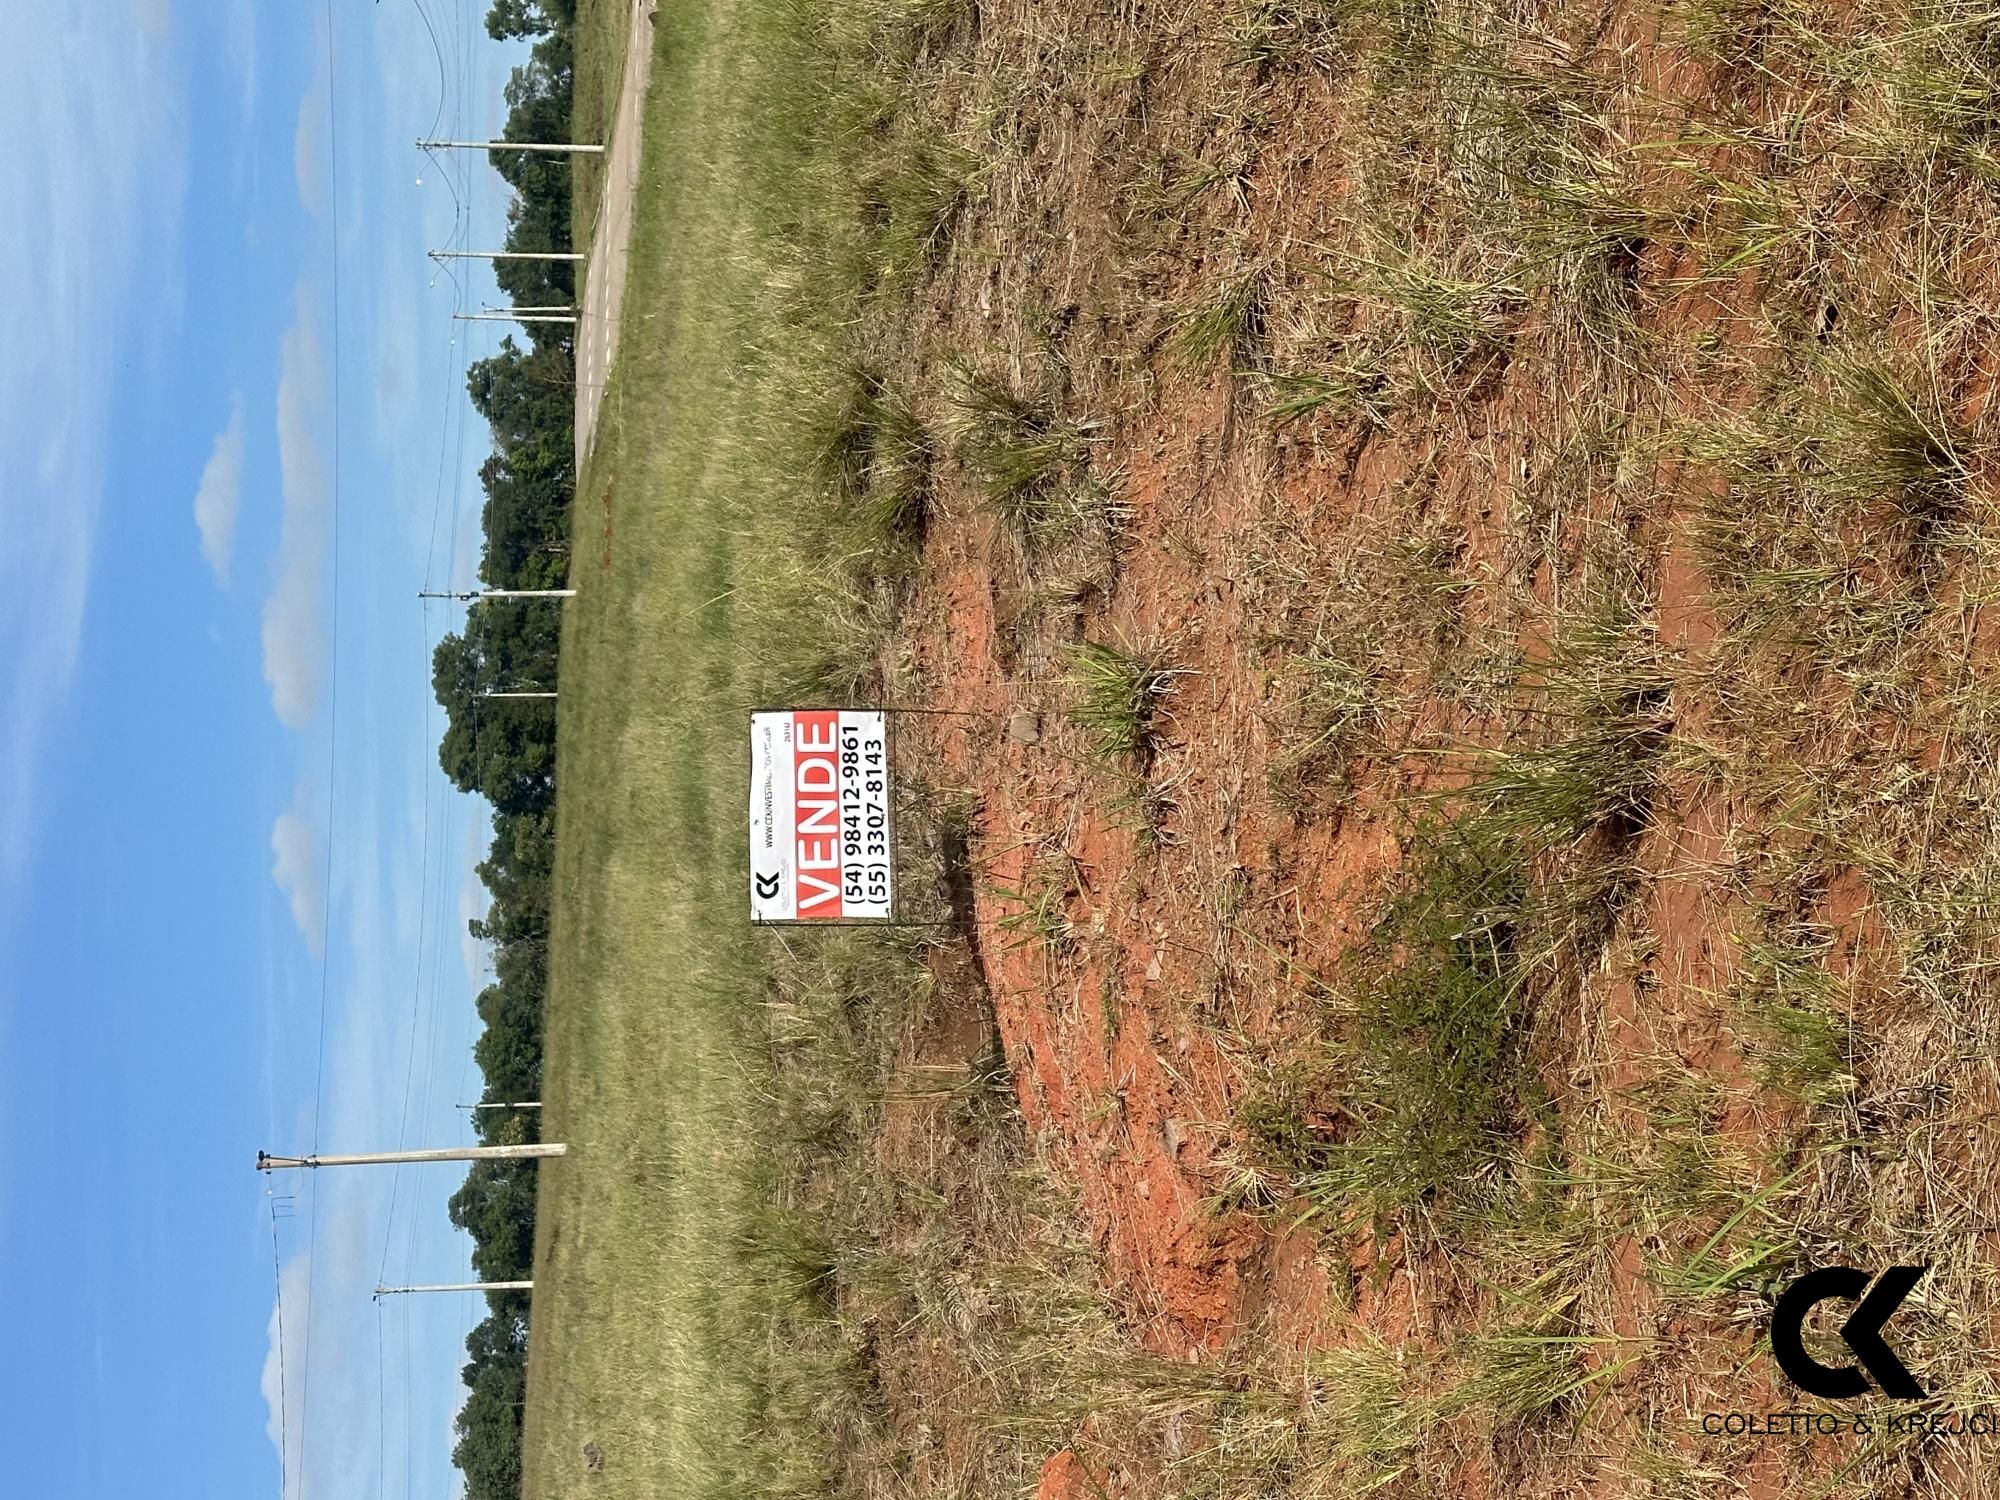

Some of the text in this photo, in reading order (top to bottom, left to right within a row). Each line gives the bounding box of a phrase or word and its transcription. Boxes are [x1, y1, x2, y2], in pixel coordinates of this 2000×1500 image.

[756, 872, 780, 899] CK
[796, 722, 840, 909] VENDE
[842, 726, 865, 904] (54) 98412-9861
[865, 740, 888, 904] (55) 3307-8143
